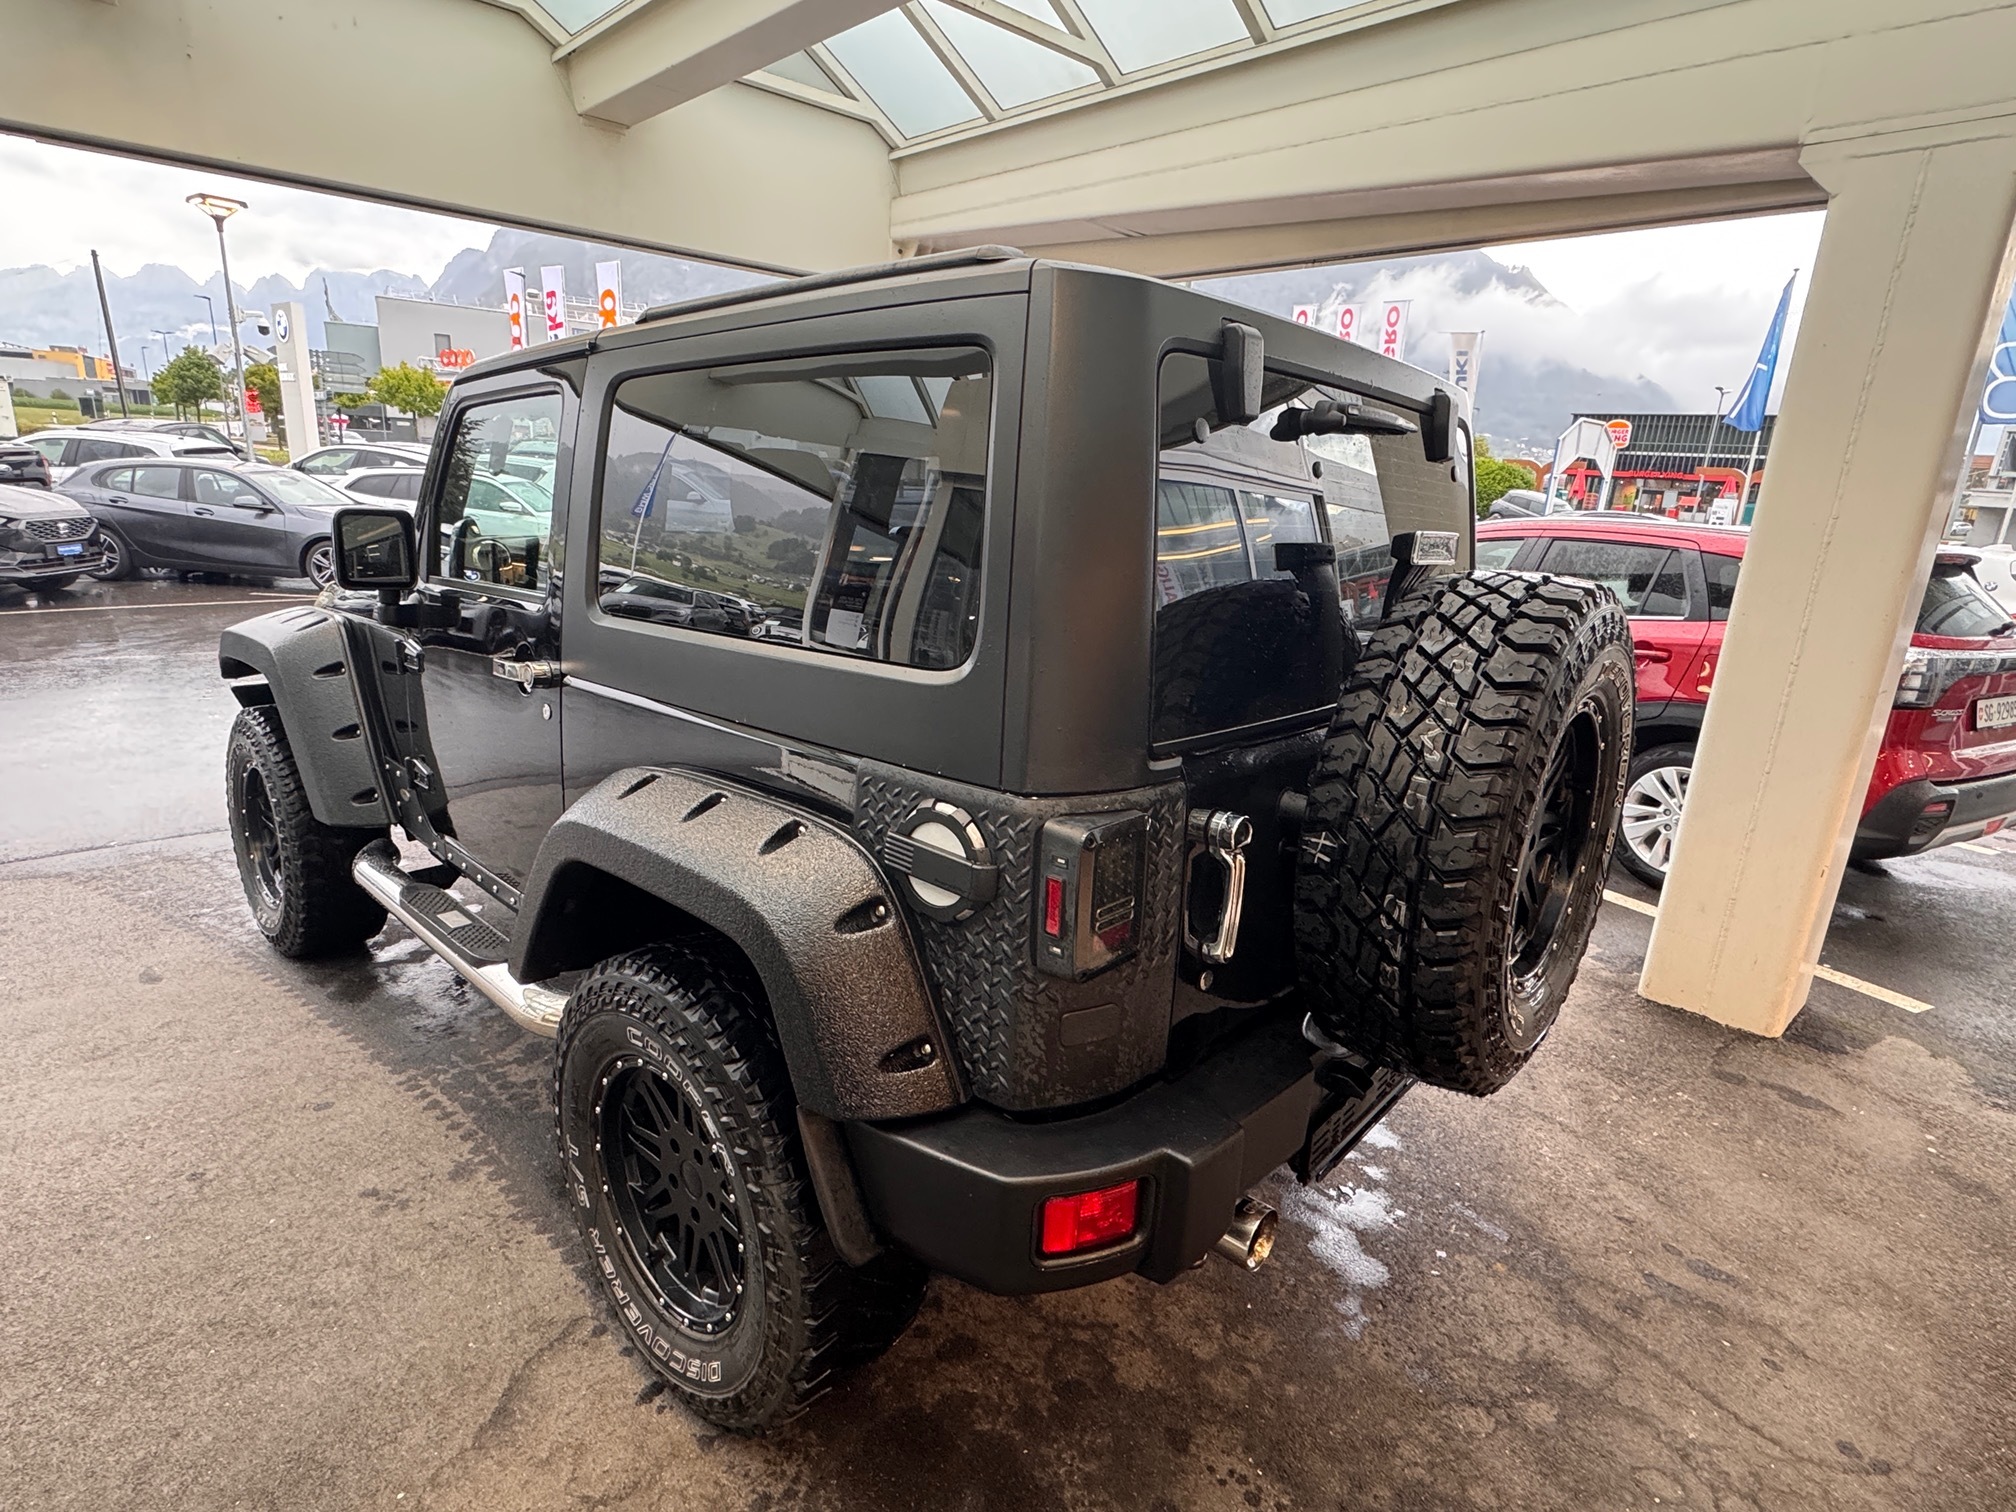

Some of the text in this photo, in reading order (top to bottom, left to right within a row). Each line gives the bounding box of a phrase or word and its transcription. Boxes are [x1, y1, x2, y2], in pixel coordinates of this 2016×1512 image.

[566, 1133, 590, 1208] S/T
[626, 1026, 735, 1177] COOPER
[588, 1228, 721, 1383] DISCOVERER
